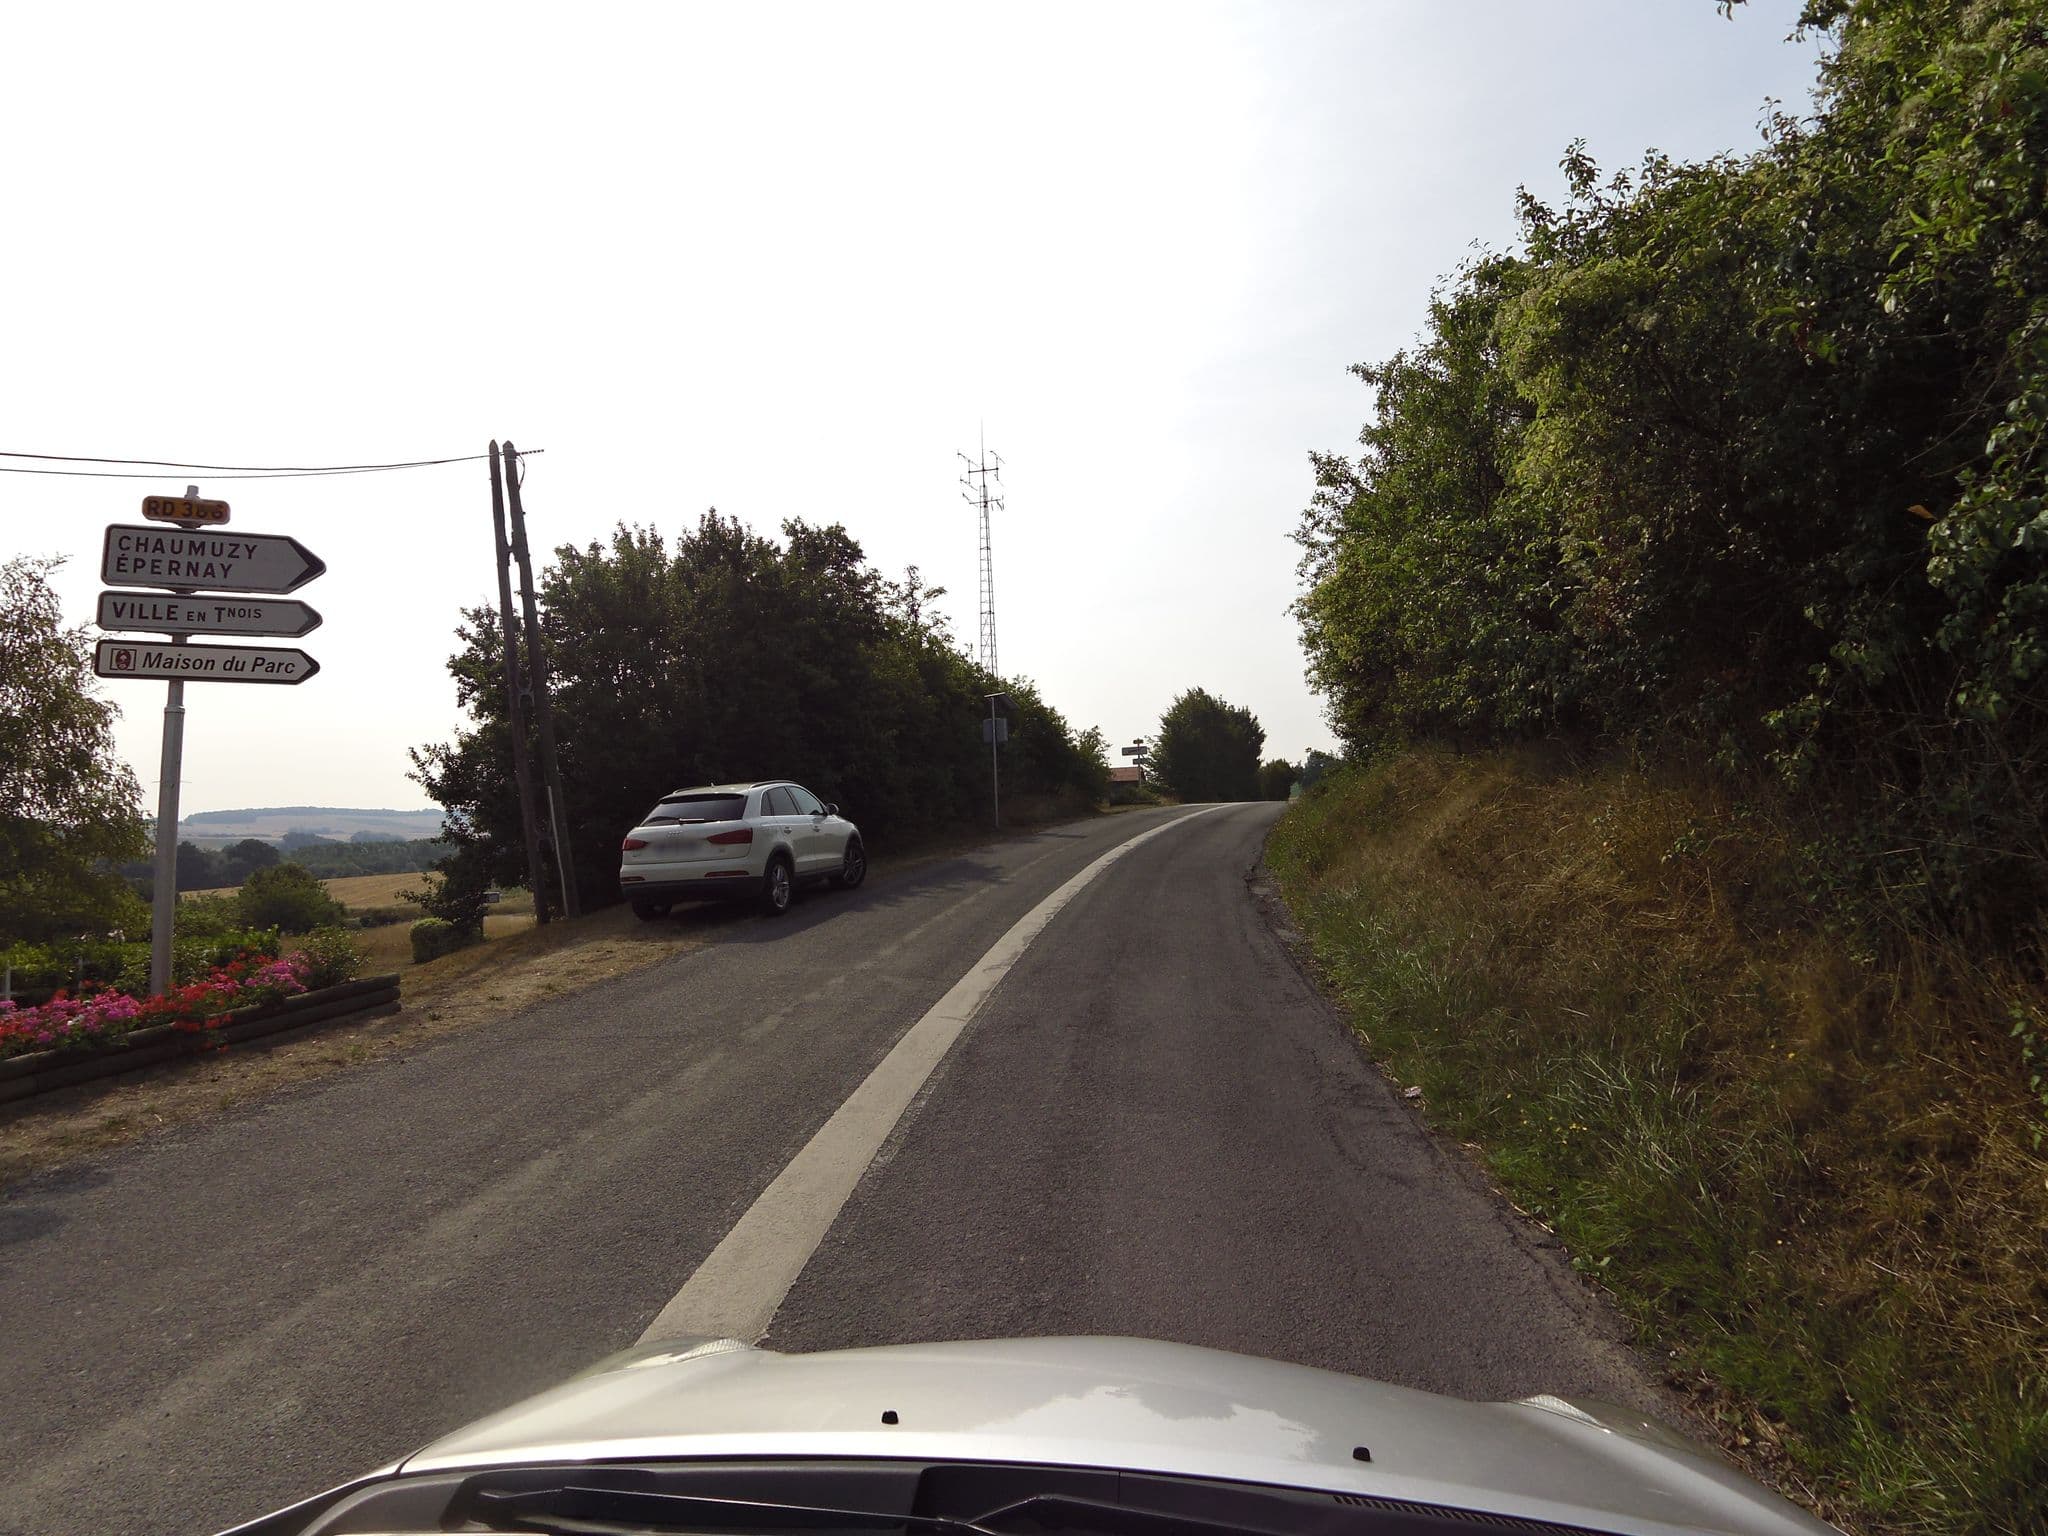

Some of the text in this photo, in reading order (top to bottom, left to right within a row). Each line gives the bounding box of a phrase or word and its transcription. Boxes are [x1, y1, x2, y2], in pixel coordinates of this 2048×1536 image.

[147, 501, 175, 516] RD
[118, 535, 258, 560] CHAUMUZY
[116, 554, 233, 579] ÉPERNAY
[112, 602, 179, 621] VILLE
[187, 611, 206, 622] EN
[142, 652, 296, 674] Maison du Parc
